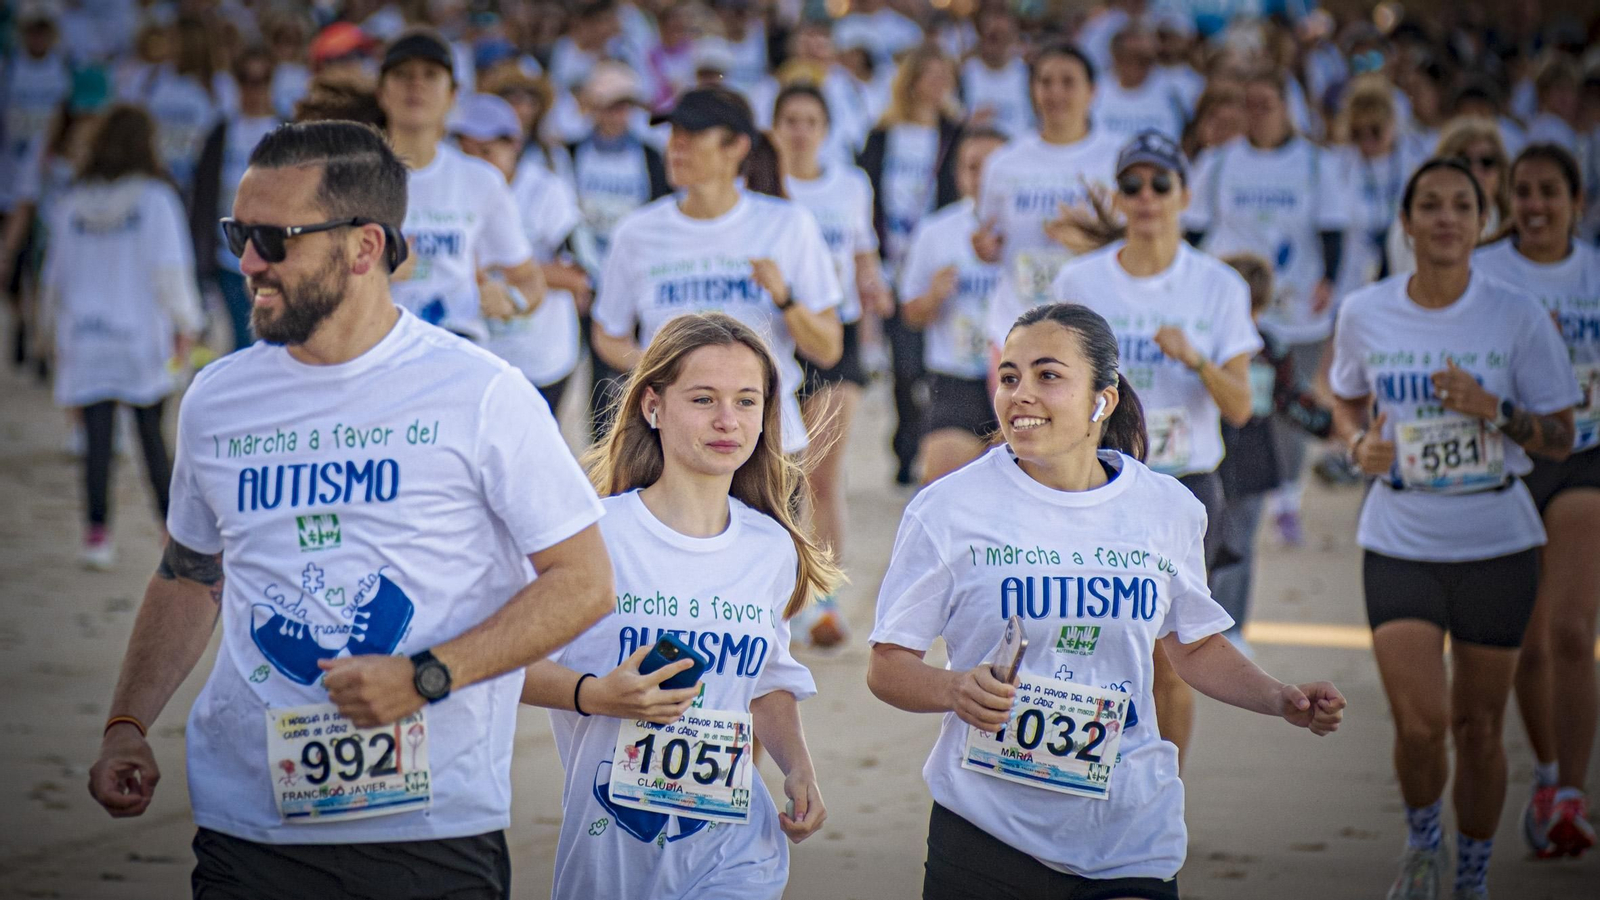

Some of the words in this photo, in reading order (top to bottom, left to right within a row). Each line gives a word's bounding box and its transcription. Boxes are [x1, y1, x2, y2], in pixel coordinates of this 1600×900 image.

[228, 428, 298, 458] marcha
[309, 429, 319, 450] a
[332, 423, 394, 449] favor
[406, 419, 439, 445] del
[1422, 437, 1479, 471] 581
[237, 458, 399, 513] AUTISMO
[986, 544, 1061, 567] marcha
[1072, 552, 1084, 566] a
[1094, 547, 1150, 569] favor
[264, 583, 312, 624] Cada
[690, 598, 699, 618] a
[711, 595, 763, 624] favor
[1001, 576, 1159, 622] AUTISMO
[1034, 685, 1041, 693] A
[1044, 687, 1068, 699] FAVOR
[1071, 693, 1083, 703] DEL
[665, 725, 675, 733] de
[679, 715, 685, 723] A
[688, 717, 711, 727] FAVOR
[714, 720, 724, 729] DEL
[301, 732, 399, 786] 992
[635, 733, 744, 788] 1057
[282, 786, 345, 801] FRANCISCO
[348, 781, 387, 795] JAVIER
[637, 777, 684, 794] CLAUDIA
